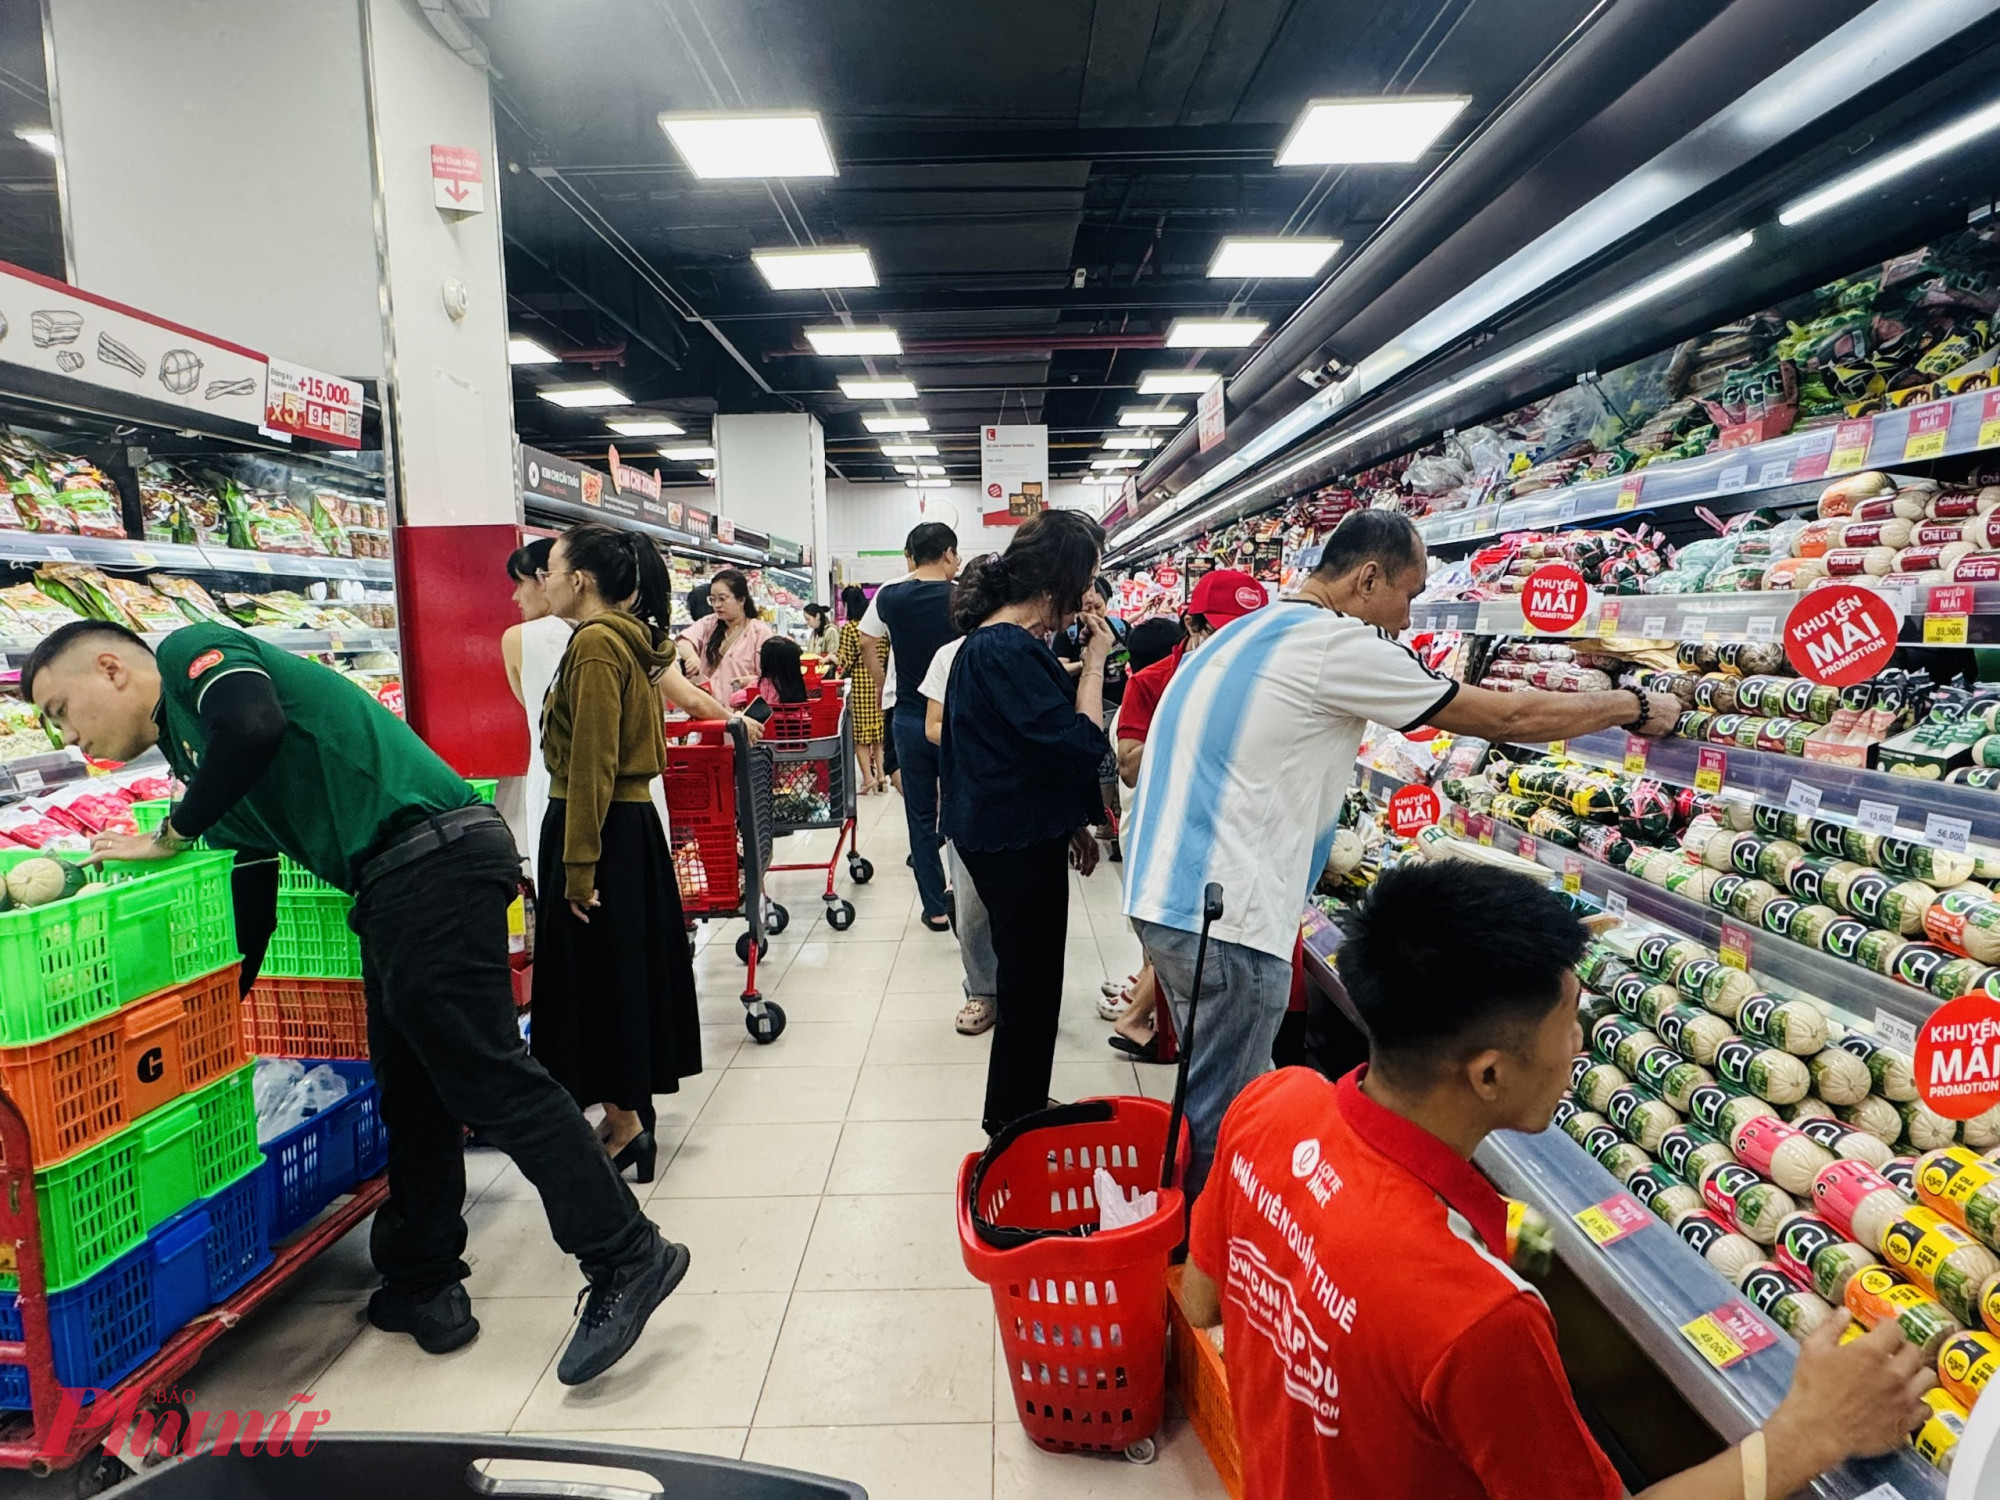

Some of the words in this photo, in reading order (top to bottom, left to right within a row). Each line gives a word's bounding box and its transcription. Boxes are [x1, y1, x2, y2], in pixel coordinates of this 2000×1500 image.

[299, 376, 350, 406] +15,000
[1532, 577, 1579, 592] KHUYẾN
[1935, 586, 1966, 599] KHUYẾN
[1529, 610, 1575, 621] PROMOTION
[1531, 588, 1577, 613] MÃI
[1939, 596, 1961, 610] MÃI
[1791, 594, 1863, 642] KHUYẾN
[1805, 611, 1882, 670] MÃI
[1818, 637, 1887, 680] PROMOTION
[1394, 792, 1431, 807] KHUYẾN
[1397, 803, 1432, 825] MÃI
[1930, 1017, 2000, 1043] KHUYẾN
[136, 1047, 164, 1084] G
[1930, 1038, 2000, 1084] MÃI
[1929, 1080, 1999, 1098] PROMOTION
[1318, 1159, 1343, 1195] LOTTE
[1306, 1176, 1334, 1209] Mart
[1257, 1185, 1291, 1237] VIÊN
[1251, 1270, 1282, 1311] CAN
